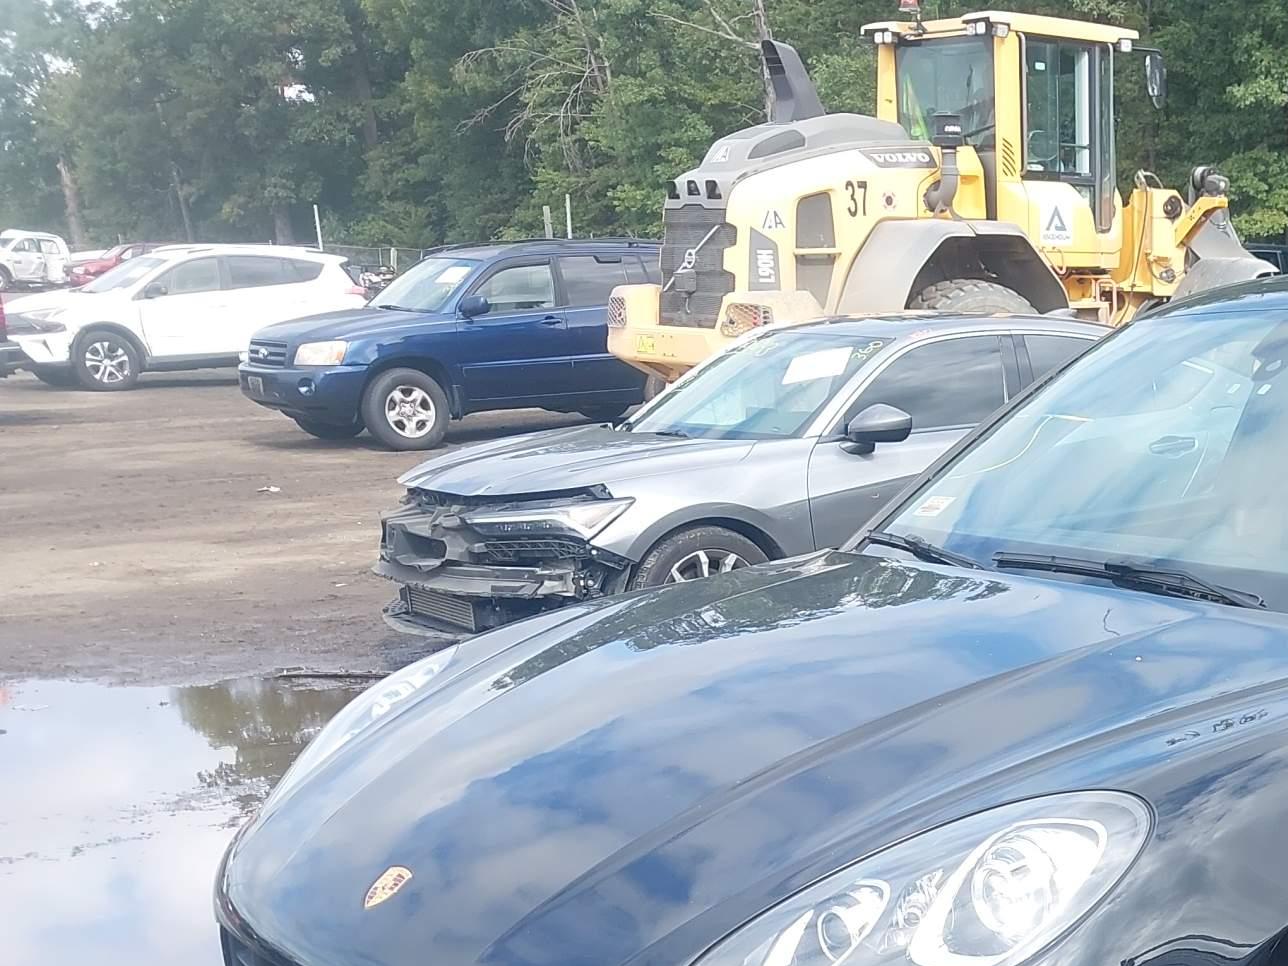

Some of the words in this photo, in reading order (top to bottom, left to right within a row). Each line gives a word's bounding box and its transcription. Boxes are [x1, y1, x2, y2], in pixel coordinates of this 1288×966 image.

[869, 152, 931, 164] VOLVO
[845, 180, 868, 218] 37
[756, 249, 776, 284] L90H
[852, 340, 884, 361] 360
